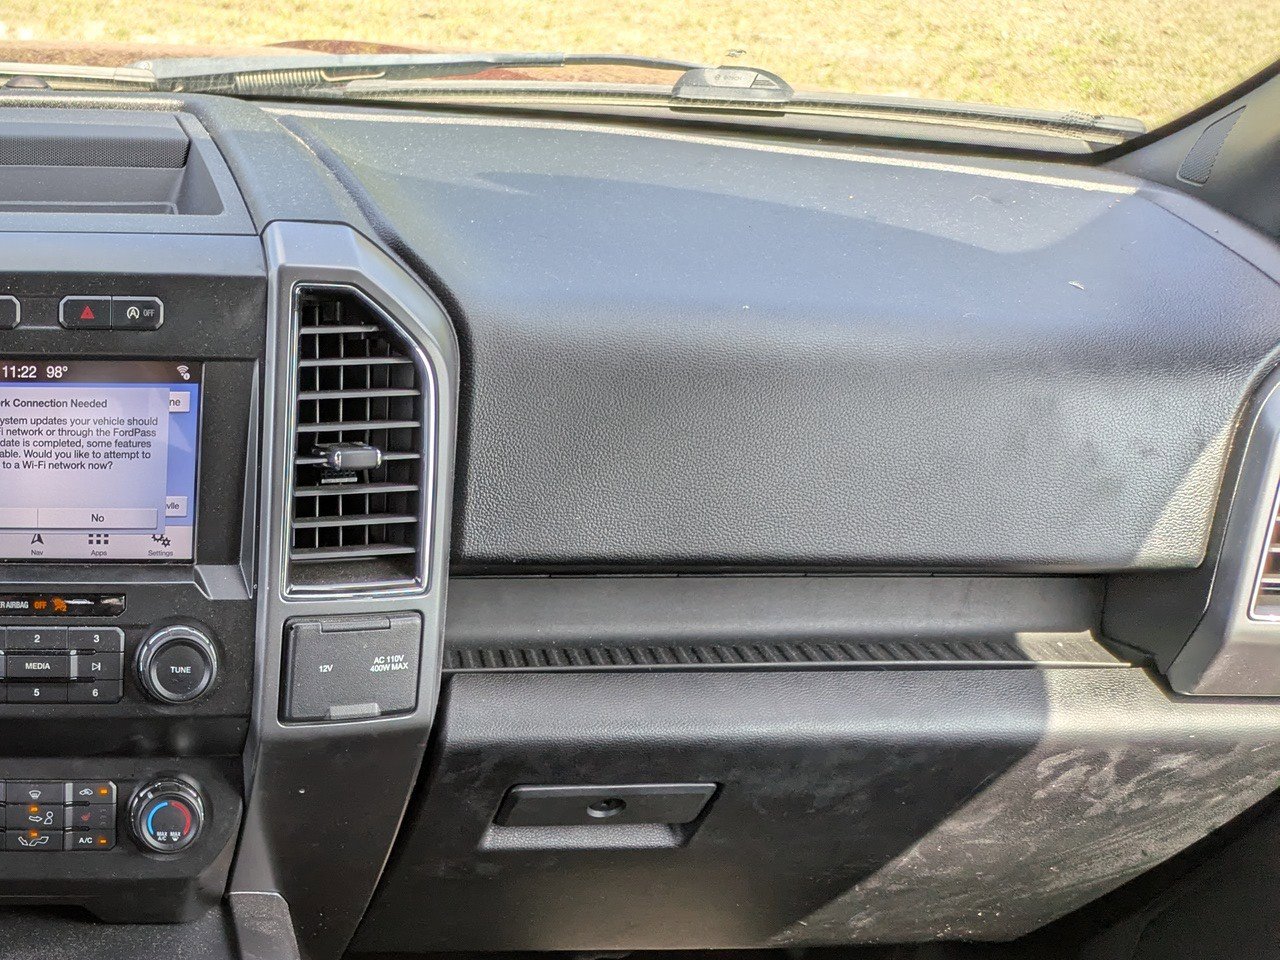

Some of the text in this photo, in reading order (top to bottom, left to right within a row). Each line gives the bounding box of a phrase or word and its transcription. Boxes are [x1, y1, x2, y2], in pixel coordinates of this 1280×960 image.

[143, 309, 154, 317] OFF
[2, 366, 68, 378] 11:22 98°
[13, 399, 67, 408] Connection
[70, 399, 107, 408] Needed
[30, 416, 67, 427] updates
[70, 418, 91, 427] your
[92, 417, 124, 425] vehicle
[127, 417, 158, 426] should
[6, 427, 44, 436] network
[58, 428, 93, 438] through
[96, 428, 110, 436] the
[113, 428, 156, 436] FordPass
[23, 439, 30, 447] is
[33, 439, 84, 449] completed,
[114, 440, 151, 448] features
[24, 450, 52, 458] Would
[54, 452, 70, 460] you
[74, 450, 89, 459] like
[92, 450, 101, 459] to
[104, 450, 139, 460] attempt
[142, 450, 151, 459] to
[3, 461, 12, 469] to
[22, 461, 45, 469] Wi-Fi
[48, 461, 85, 469] network
[88, 461, 113, 469] now?
[91, 514, 104, 522] No
[6, 601, 28, 609] AIRBAG
[370, 662, 409, 672] 400W MAX
